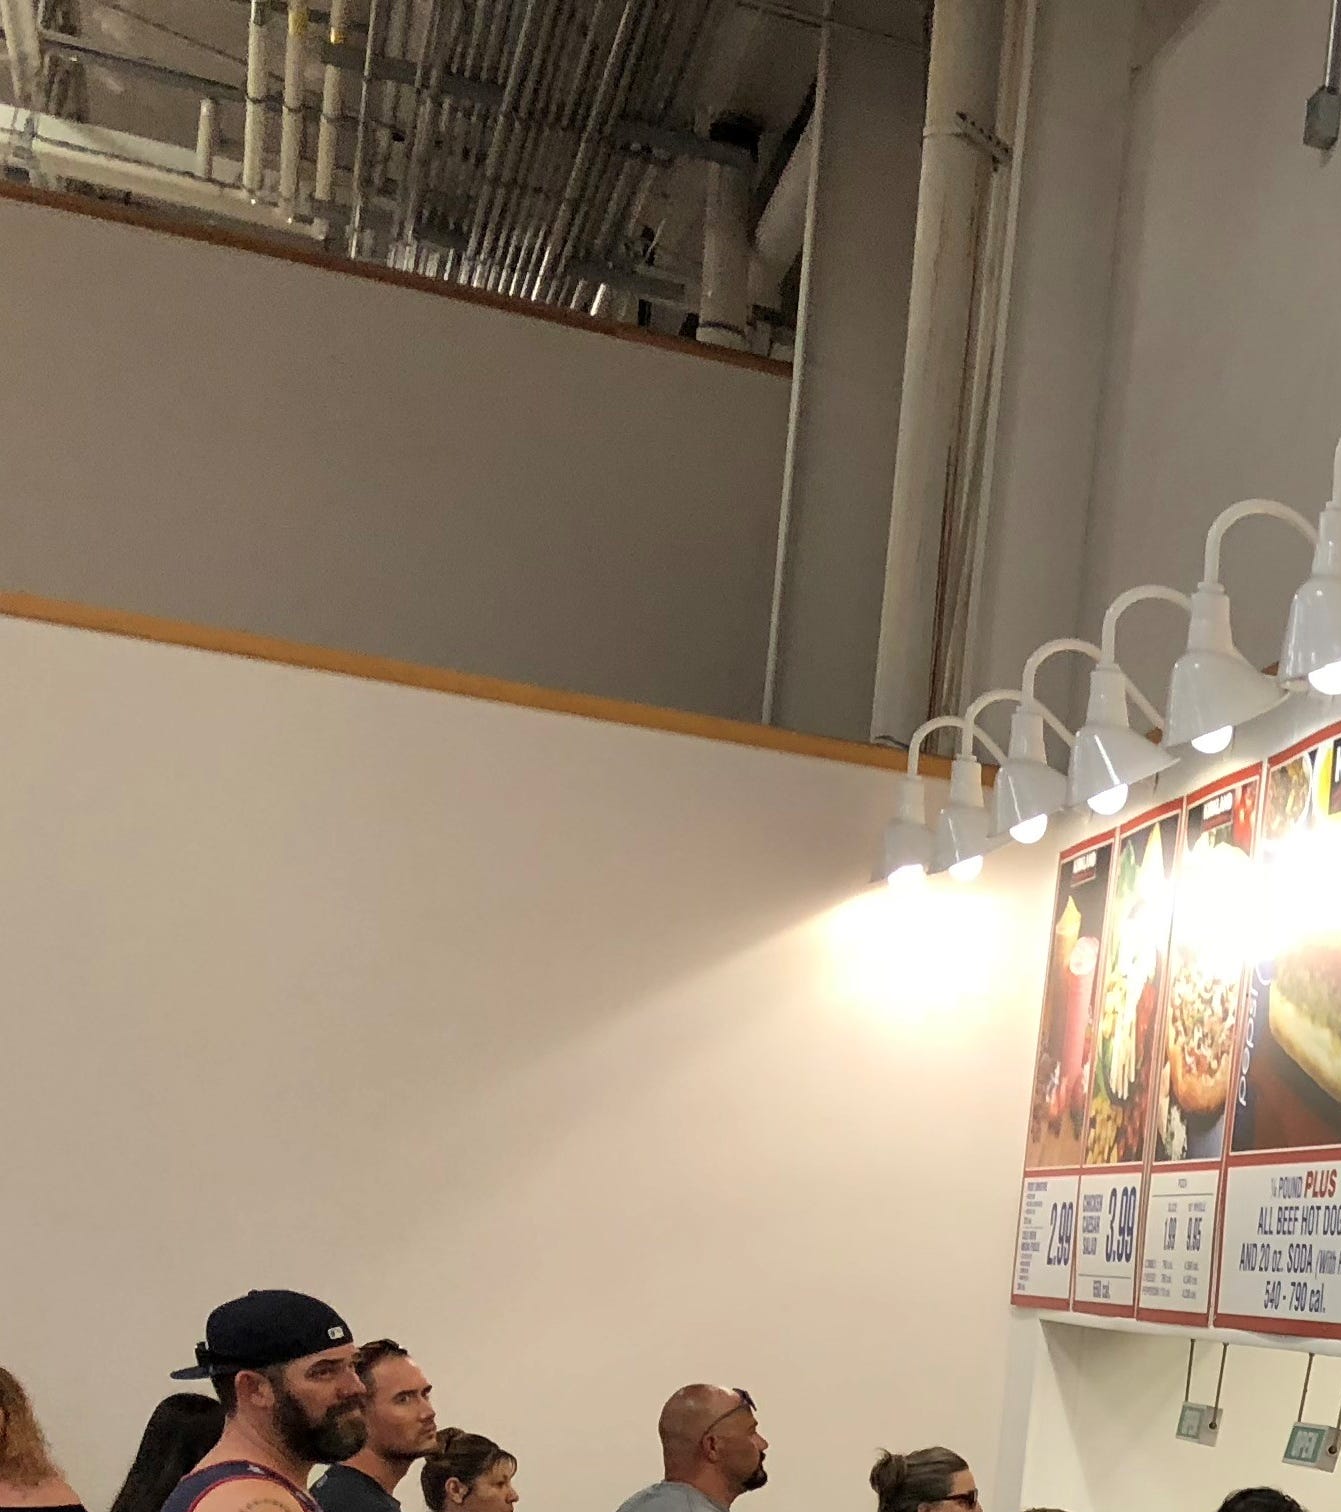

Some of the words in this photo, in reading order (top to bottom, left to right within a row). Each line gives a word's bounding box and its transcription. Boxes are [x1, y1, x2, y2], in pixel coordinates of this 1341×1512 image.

[1278, 1177, 1303, 1199] POUND
[1304, 1169, 1338, 1199] PLUS
[1047, 1202, 1073, 1266] 2.99
[1105, 1186, 1136, 1263] 3.99
[1257, 1207, 1274, 1235] ALL
[1276, 1206, 1299, 1236] BEEF
[1300, 1205, 1322, 1235] HOT
[1239, 1243, 1258, 1272] AND
[1258, 1243, 1271, 1272] 20
[1272, 1250, 1284, 1273] oz.
[1287, 1243, 1314, 1274] SODA
[1264, 1280, 1282, 1311] 540
[1288, 1281, 1308, 1312] 790
[1308, 1282, 1326, 1314] cal.
